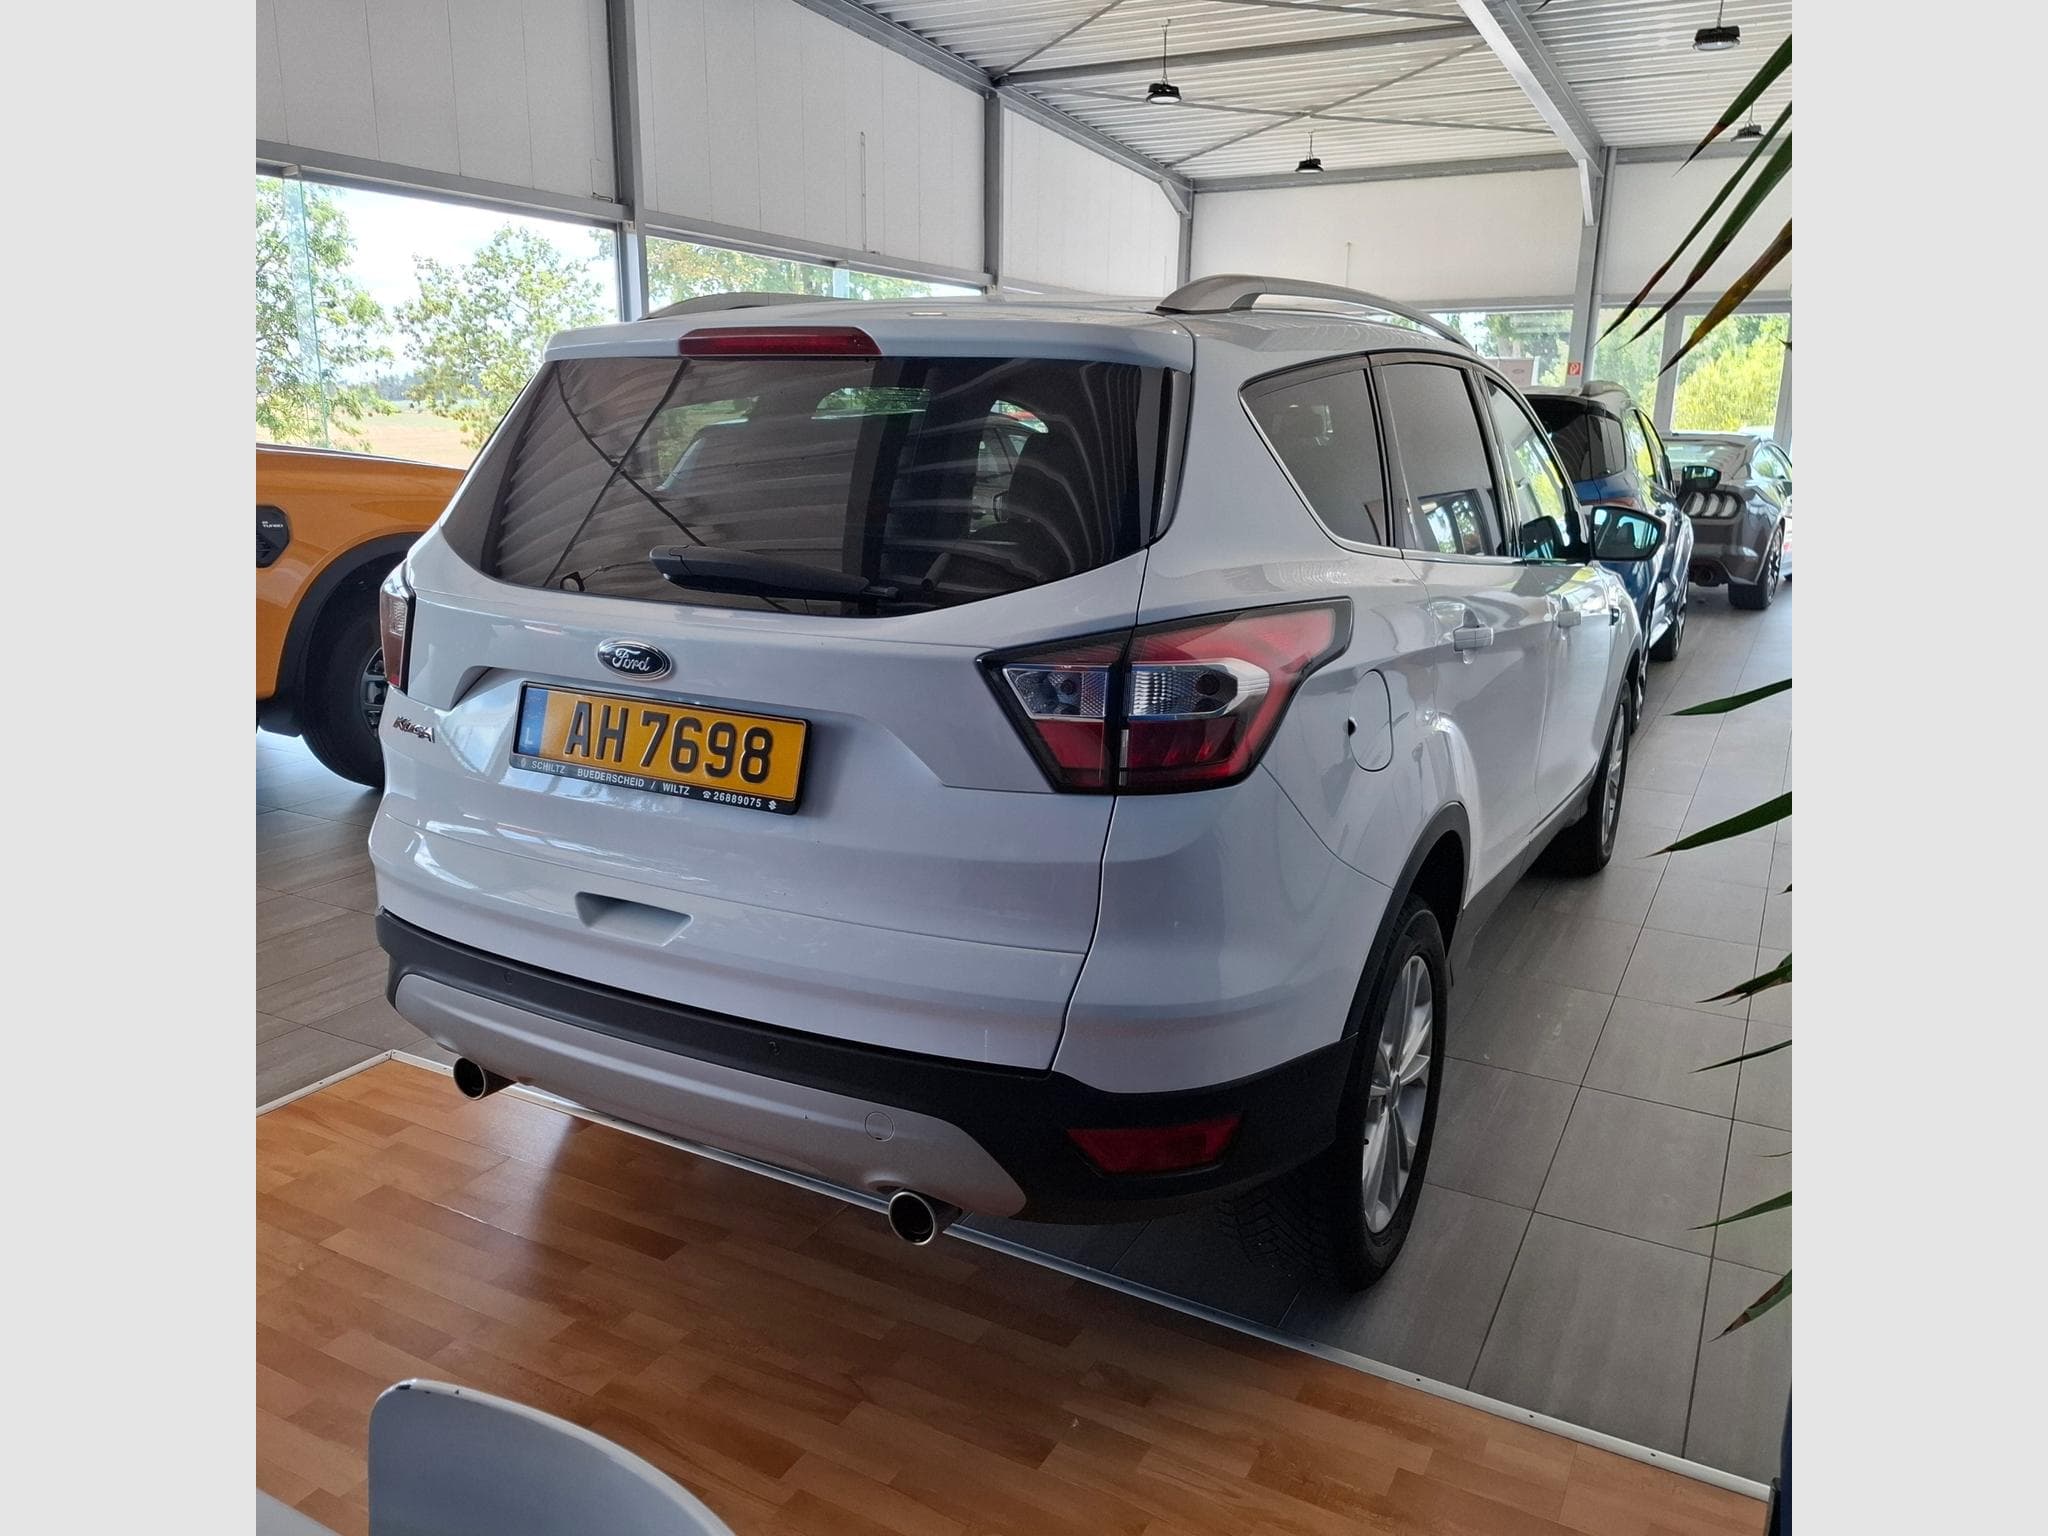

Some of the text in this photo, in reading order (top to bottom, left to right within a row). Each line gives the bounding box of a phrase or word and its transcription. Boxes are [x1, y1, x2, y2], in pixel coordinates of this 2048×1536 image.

[611, 647, 651, 672] Ford
[564, 701, 774, 784] AH 7698
[531, 760, 566, 774] SCHILTZ
[577, 768, 645, 789] BUEDERSCHEID
[662, 780, 690, 796] WILTZ
[712, 790, 762, 808] 26889075
